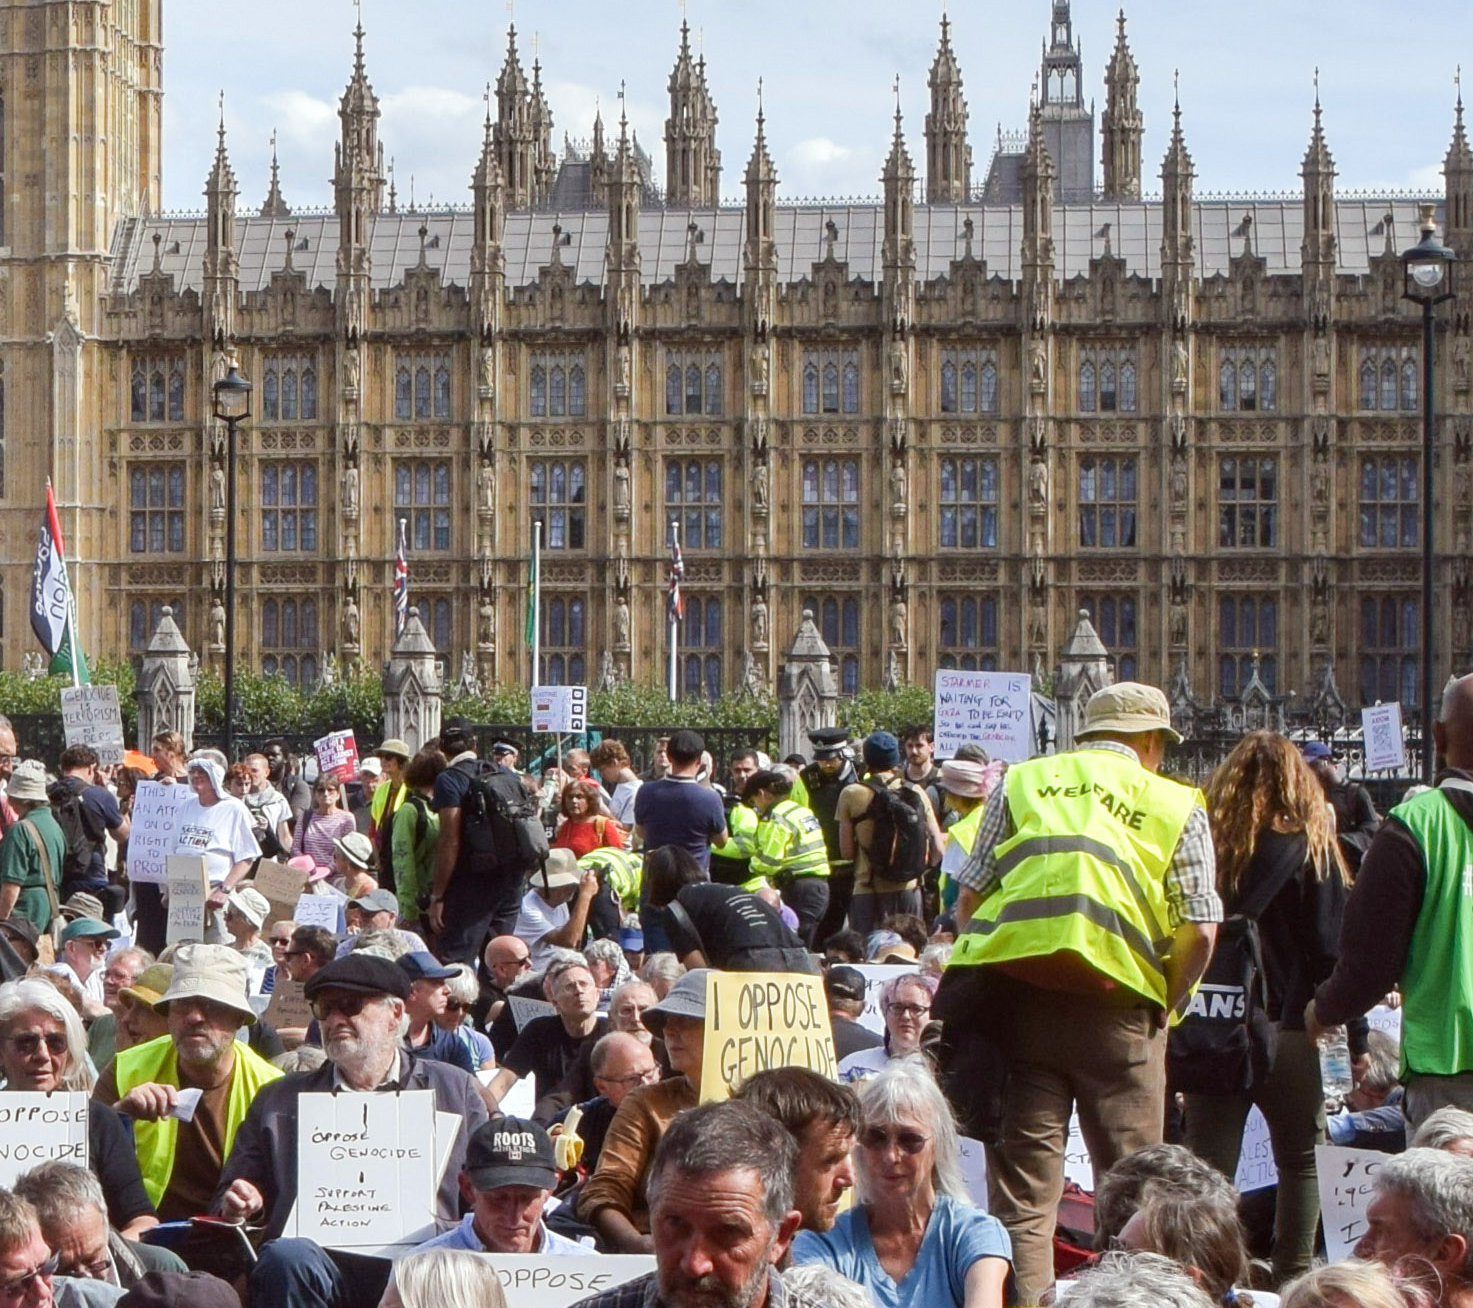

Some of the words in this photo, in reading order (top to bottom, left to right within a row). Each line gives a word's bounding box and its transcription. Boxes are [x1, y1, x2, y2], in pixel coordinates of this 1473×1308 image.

[1007, 681, 1021, 692] IS
[141, 786, 166, 798] THIS
[1037, 783, 1147, 830] WELFARE
[134, 836, 167, 847] RIGHT
[713, 981, 721, 1031] I
[738, 981, 822, 1031] OPPOSE
[1186, 993, 1246, 1019] ANS
[311, 1127, 371, 1144] OPPOSE
[493, 1131, 536, 1147] ROOTS
[330, 1146, 423, 1161] GENOCIDE
[314, 1187, 377, 1199] SUPPORT
[316, 1200, 392, 1213] PALESTINE
[319, 1217, 372, 1228] ACTION
